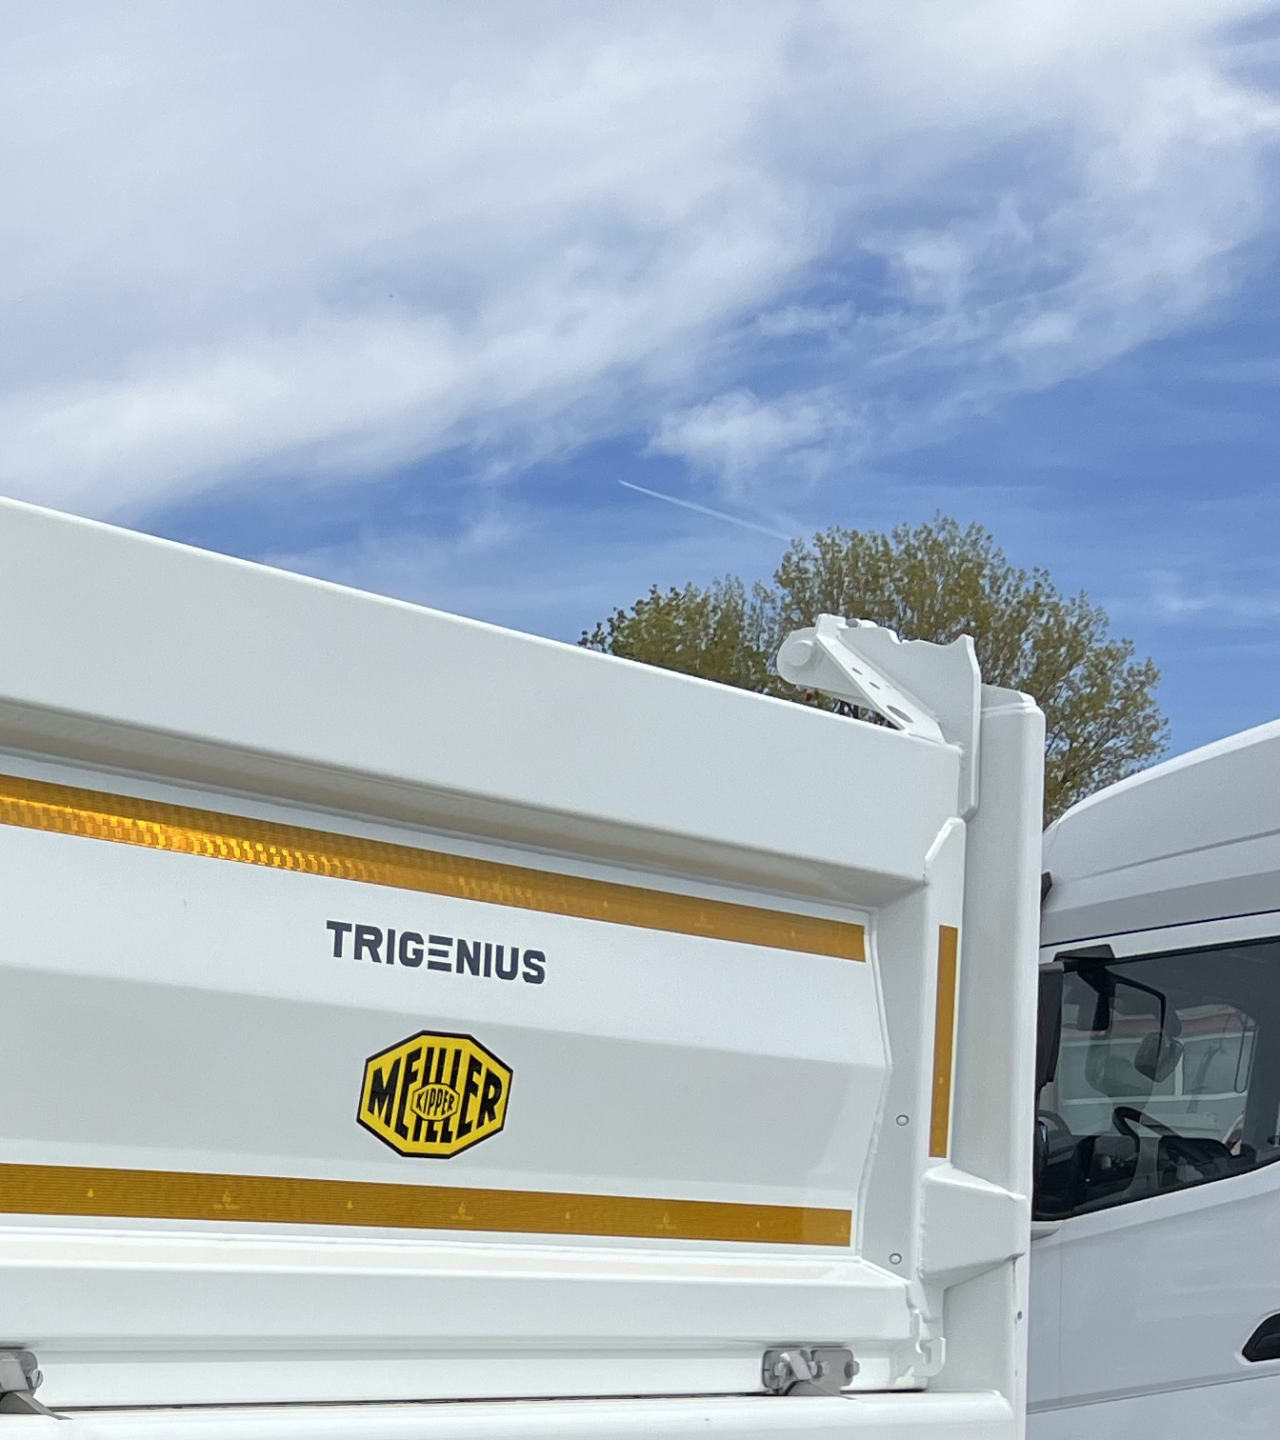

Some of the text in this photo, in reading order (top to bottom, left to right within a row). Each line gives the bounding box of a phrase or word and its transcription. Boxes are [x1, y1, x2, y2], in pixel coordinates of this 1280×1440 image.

[326, 919, 547, 985] TRIGENIUS
[367, 1046, 503, 1144] MEILLER
[415, 1087, 455, 1116] KIPPER
